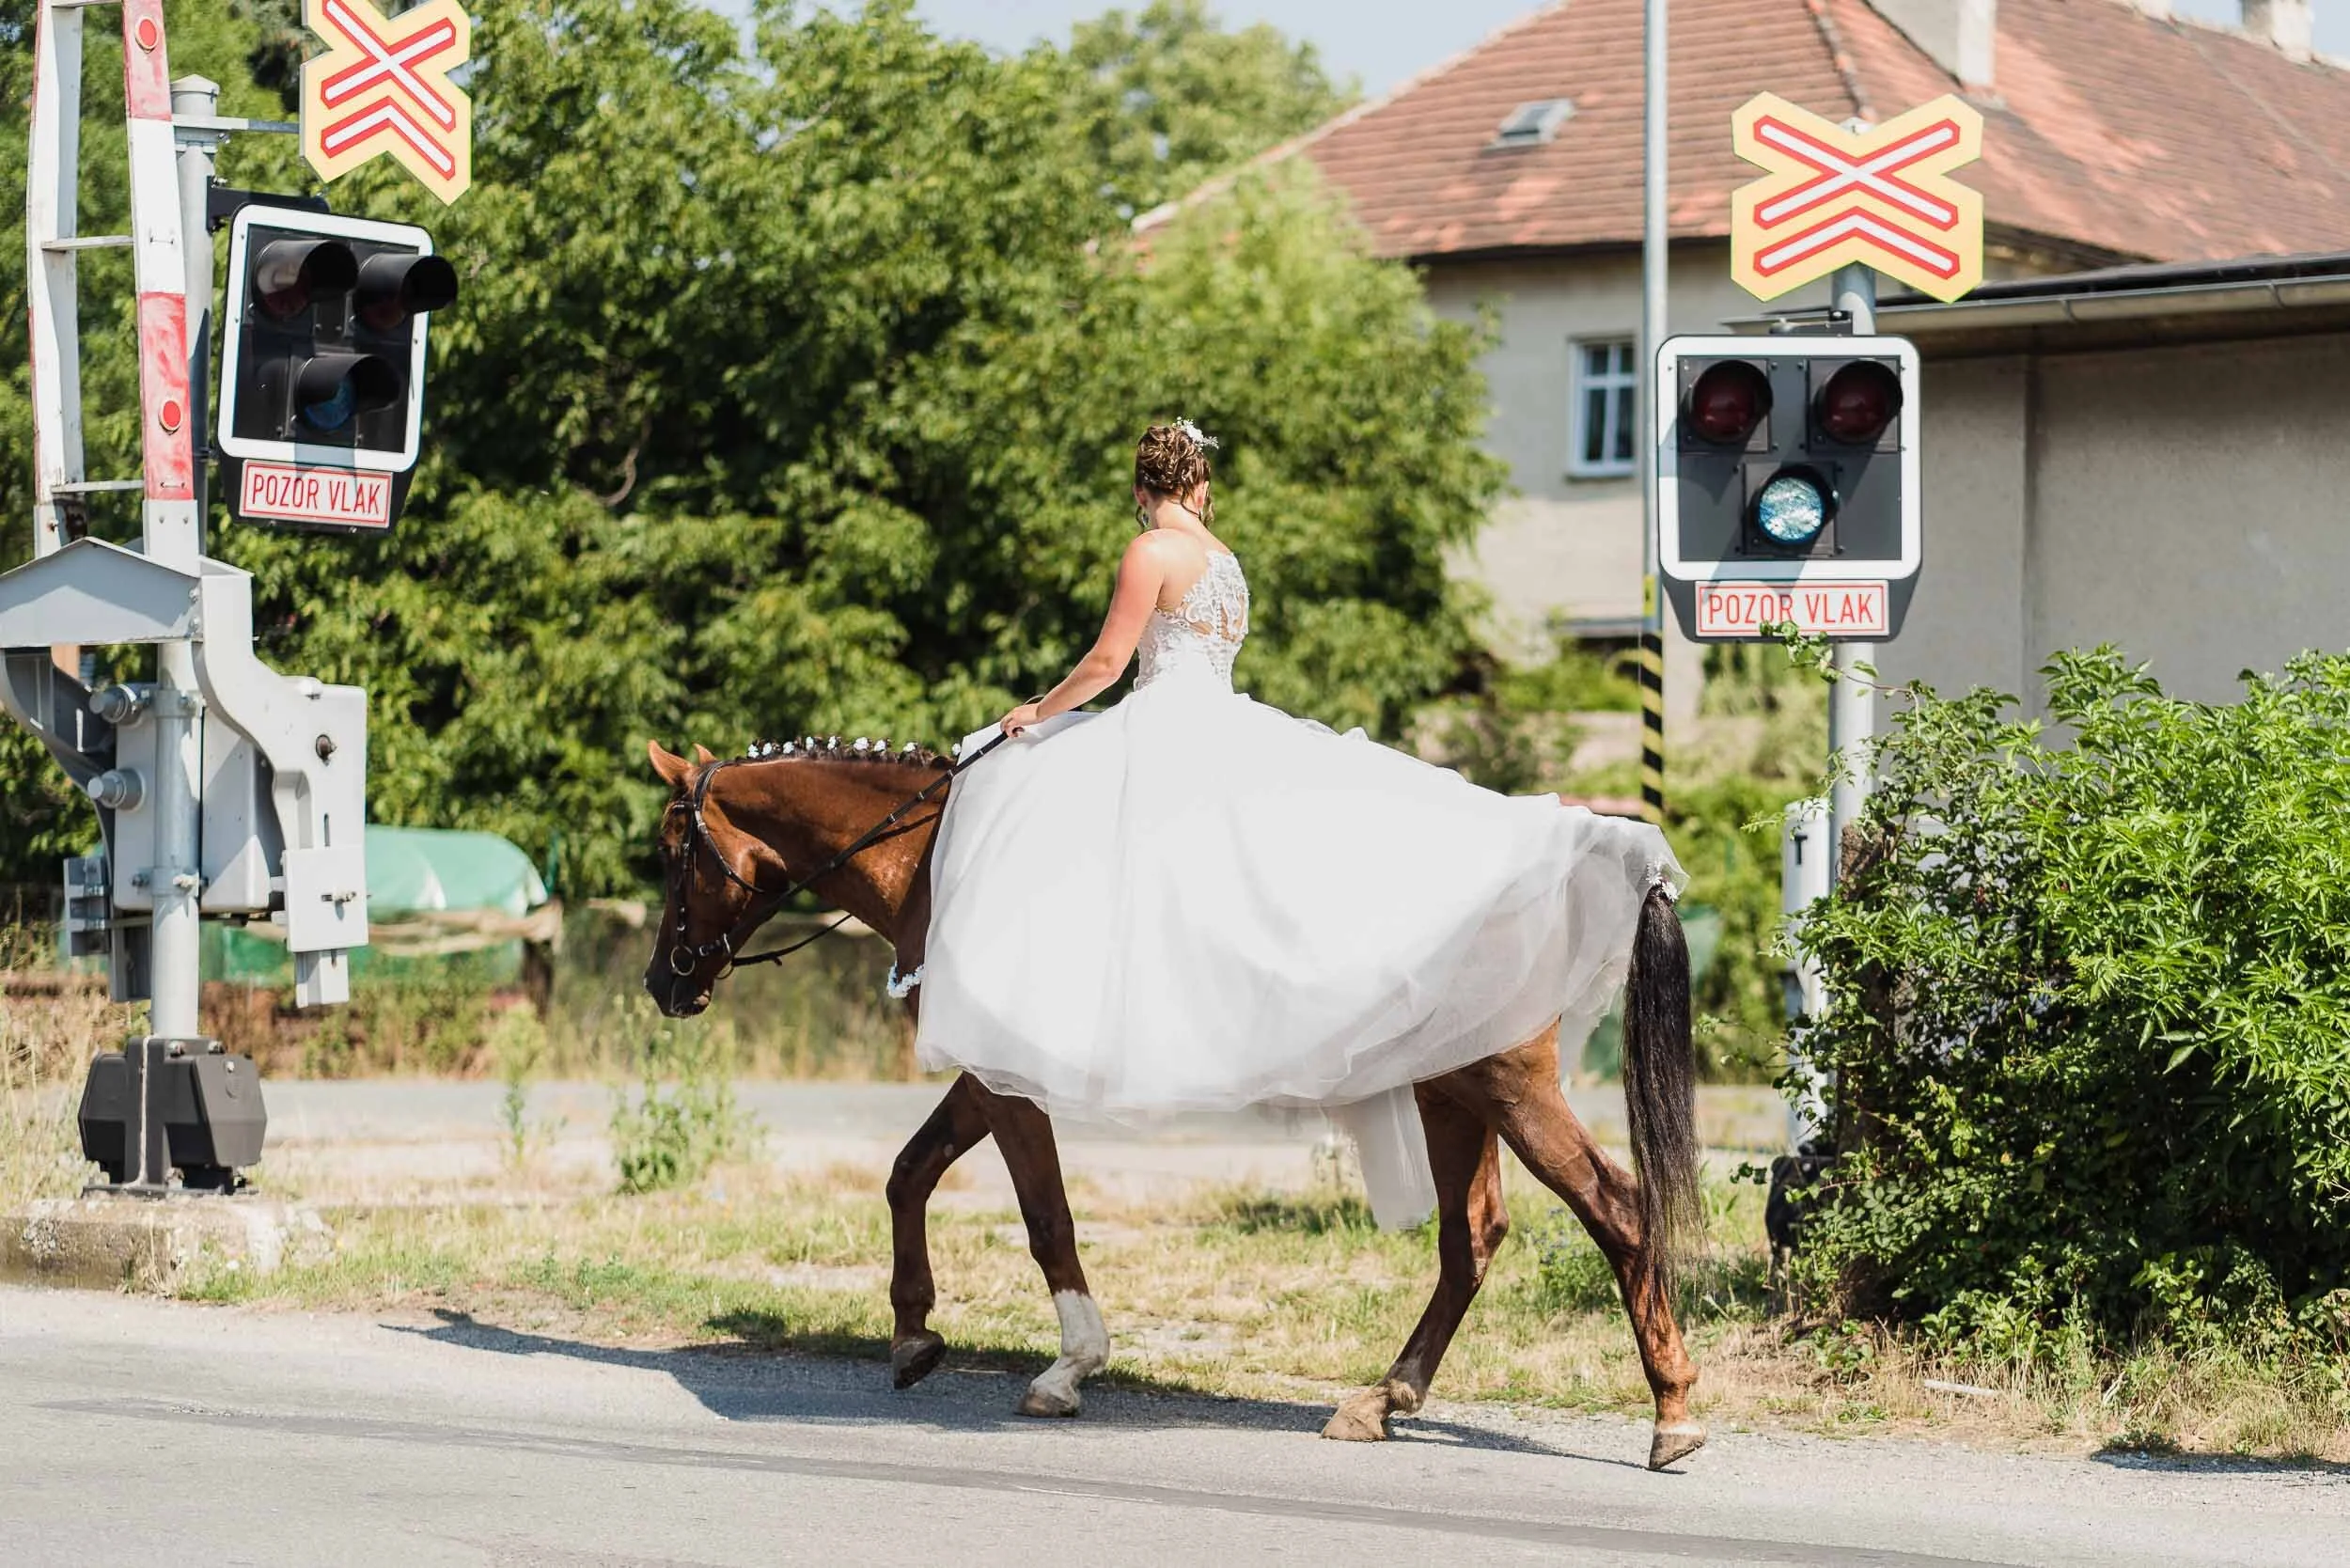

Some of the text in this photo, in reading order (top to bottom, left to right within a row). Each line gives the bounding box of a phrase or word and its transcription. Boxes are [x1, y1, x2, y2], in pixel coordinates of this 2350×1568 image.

[252, 473, 381, 515] POZOR VLAK
[1708, 593, 1873, 624] POZOR VLAK
